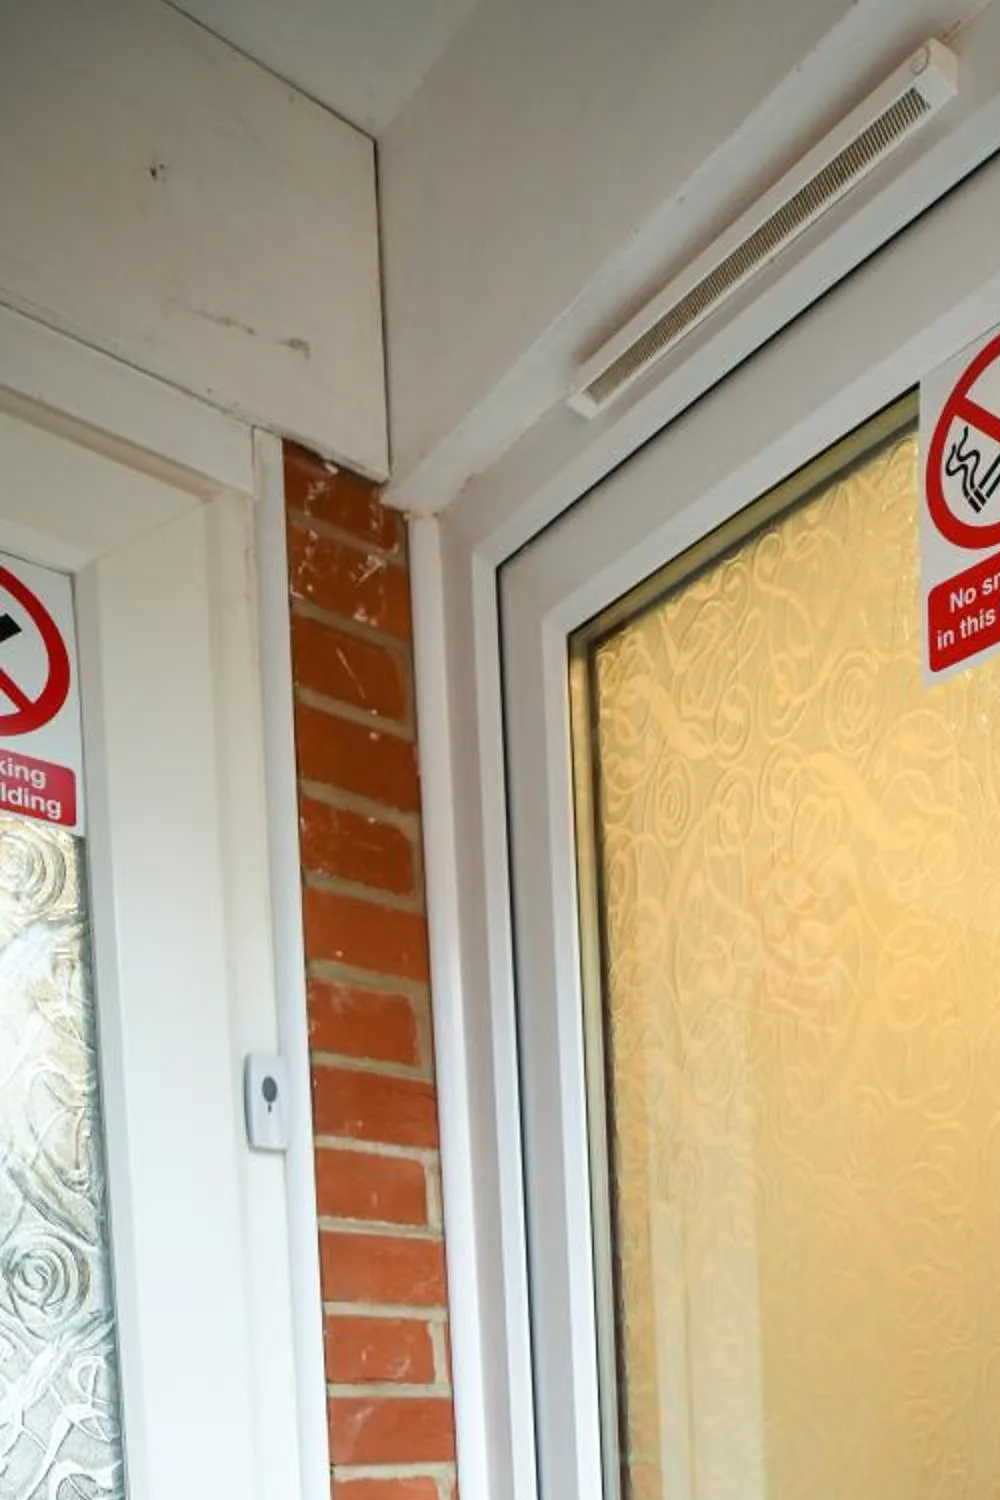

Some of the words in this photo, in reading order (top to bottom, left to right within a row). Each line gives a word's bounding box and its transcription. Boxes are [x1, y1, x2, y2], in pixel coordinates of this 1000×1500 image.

[949, 586, 976, 613] No
[937, 629, 955, 651] in
[959, 607, 996, 639] this
